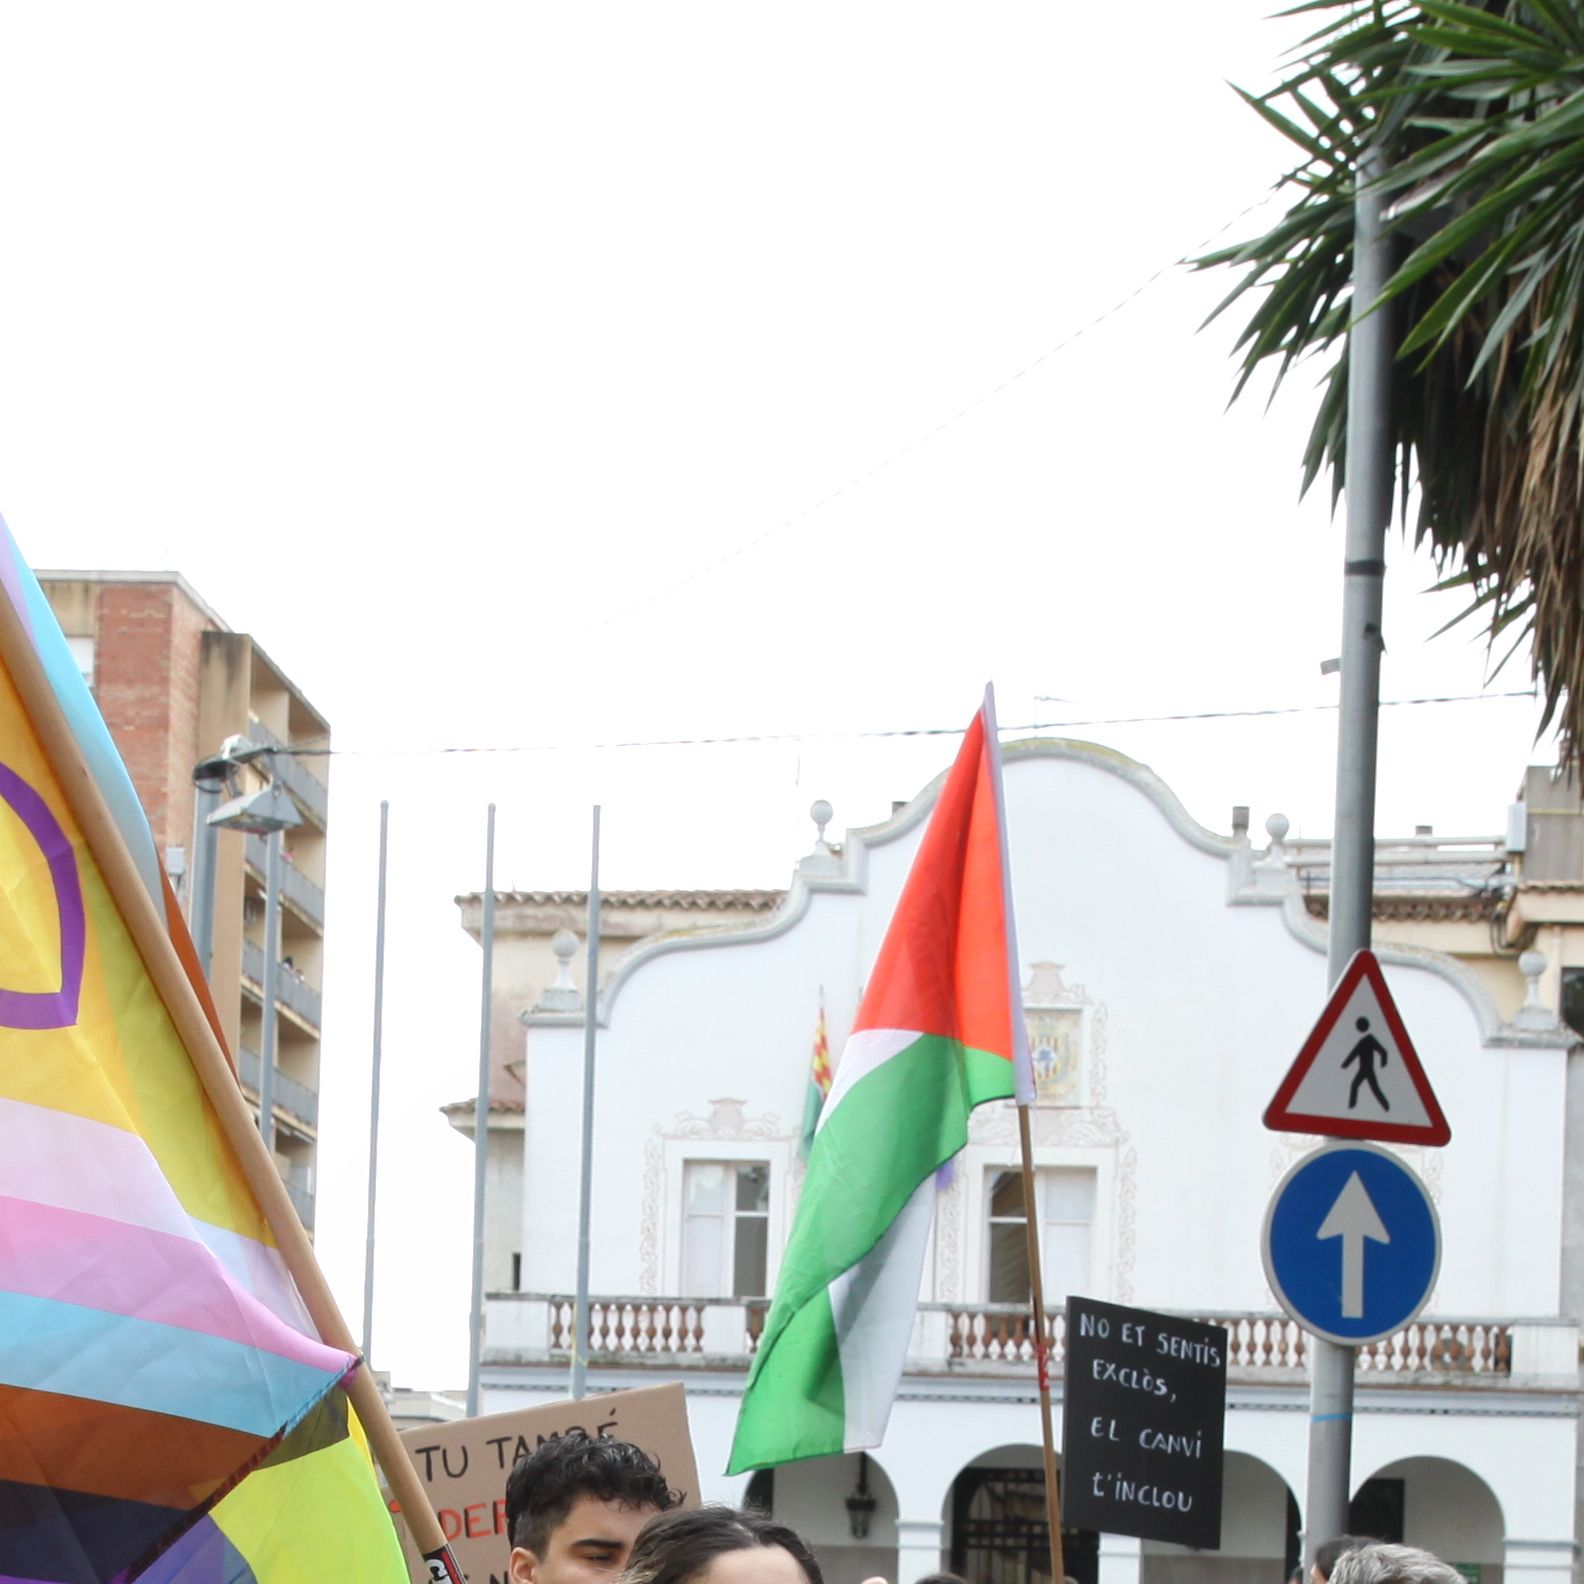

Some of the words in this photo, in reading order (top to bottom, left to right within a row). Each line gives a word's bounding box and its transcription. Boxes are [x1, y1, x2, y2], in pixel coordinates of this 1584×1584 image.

[1079, 1312, 1110, 1339] NO
[1121, 1322, 1146, 1347] ET
[1092, 1358, 1177, 1403] EXCLÒS,
[1090, 1416, 1120, 1442] EL
[415, 1444, 469, 1483] TU
